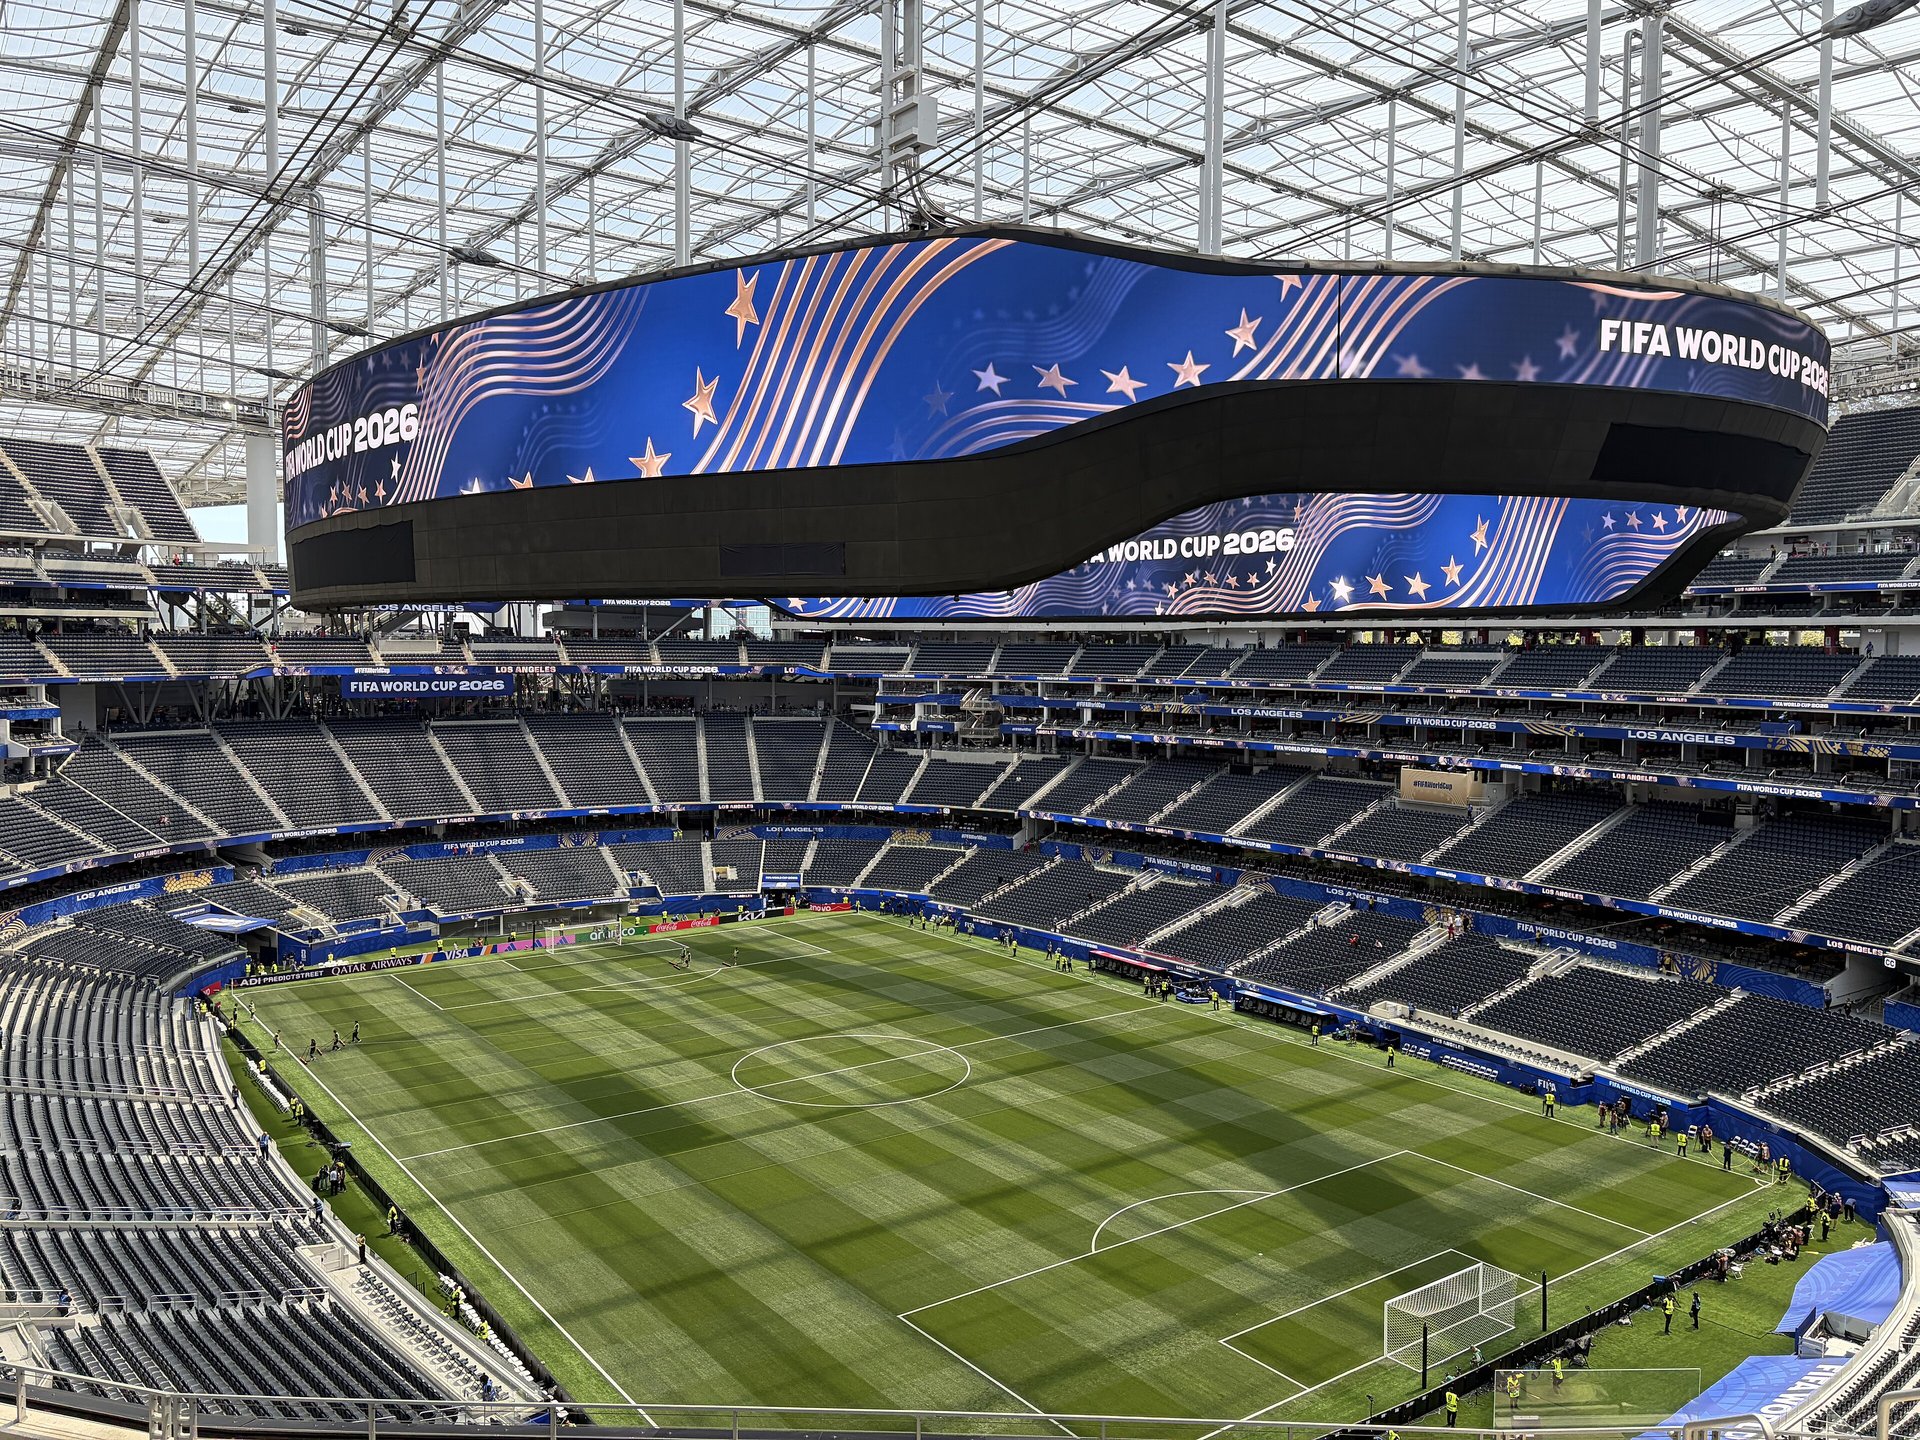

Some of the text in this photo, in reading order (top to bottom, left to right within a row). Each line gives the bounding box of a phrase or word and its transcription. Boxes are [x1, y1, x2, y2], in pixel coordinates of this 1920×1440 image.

[1600, 319, 1671, 356] FIFA
[1675, 326, 1765, 371] WORLD
[1769, 343, 1801, 381] CUP
[295, 433, 325, 476] WORLD
[326, 422, 352, 462] CUP
[354, 403, 419, 454] 2026
[1107, 539, 1178, 563] WORLD
[1180, 534, 1220, 559] CUP
[1223, 528, 1296, 555] 2026
[401, 604, 465, 612] ANGELES
[350, 680, 505, 692] FIFA WORLD CUP 2026
[1231, 708, 1303, 718] LOS ANGELES
[1405, 717, 1497, 730] FIFA WORLD CUP 2026
[1628, 730, 1735, 745] LOS ANGELES
[1612, 772, 1658, 782] LOS ANGELES
[1737, 783, 1822, 798] FIFA WORLD CUP 2026
[285, 830, 305, 838] WORLD
[306, 829, 317, 837] CUP
[459, 841, 485, 849] WORLD
[133, 847, 170, 859] LOS ANGELES
[1156, 858, 1177, 867] WORLD
[1190, 864, 1212, 873] 2026
[76, 883, 141, 901] LOS ANGELES
[1326, 887, 1344, 896] LOS
[1555, 890, 1584, 901] ANGELES
[1659, 908, 1738, 929] FIFA WORLD CUP 2026
[590, 927, 636, 941] armco
[1517, 922, 1617, 950] FIFA WORLD CUP 2026
[445, 949, 469, 960] VISA
[1827, 939, 1884, 956] LOS ANGELES
[331, 957, 413, 976] QATAR AIRWAYS
[1885, 958, 1895, 967] CC
[240, 970, 324, 987] ADI PREDICTSTREET
[1609, 1080, 1671, 1106] FIFA WORLD CUP 2026
